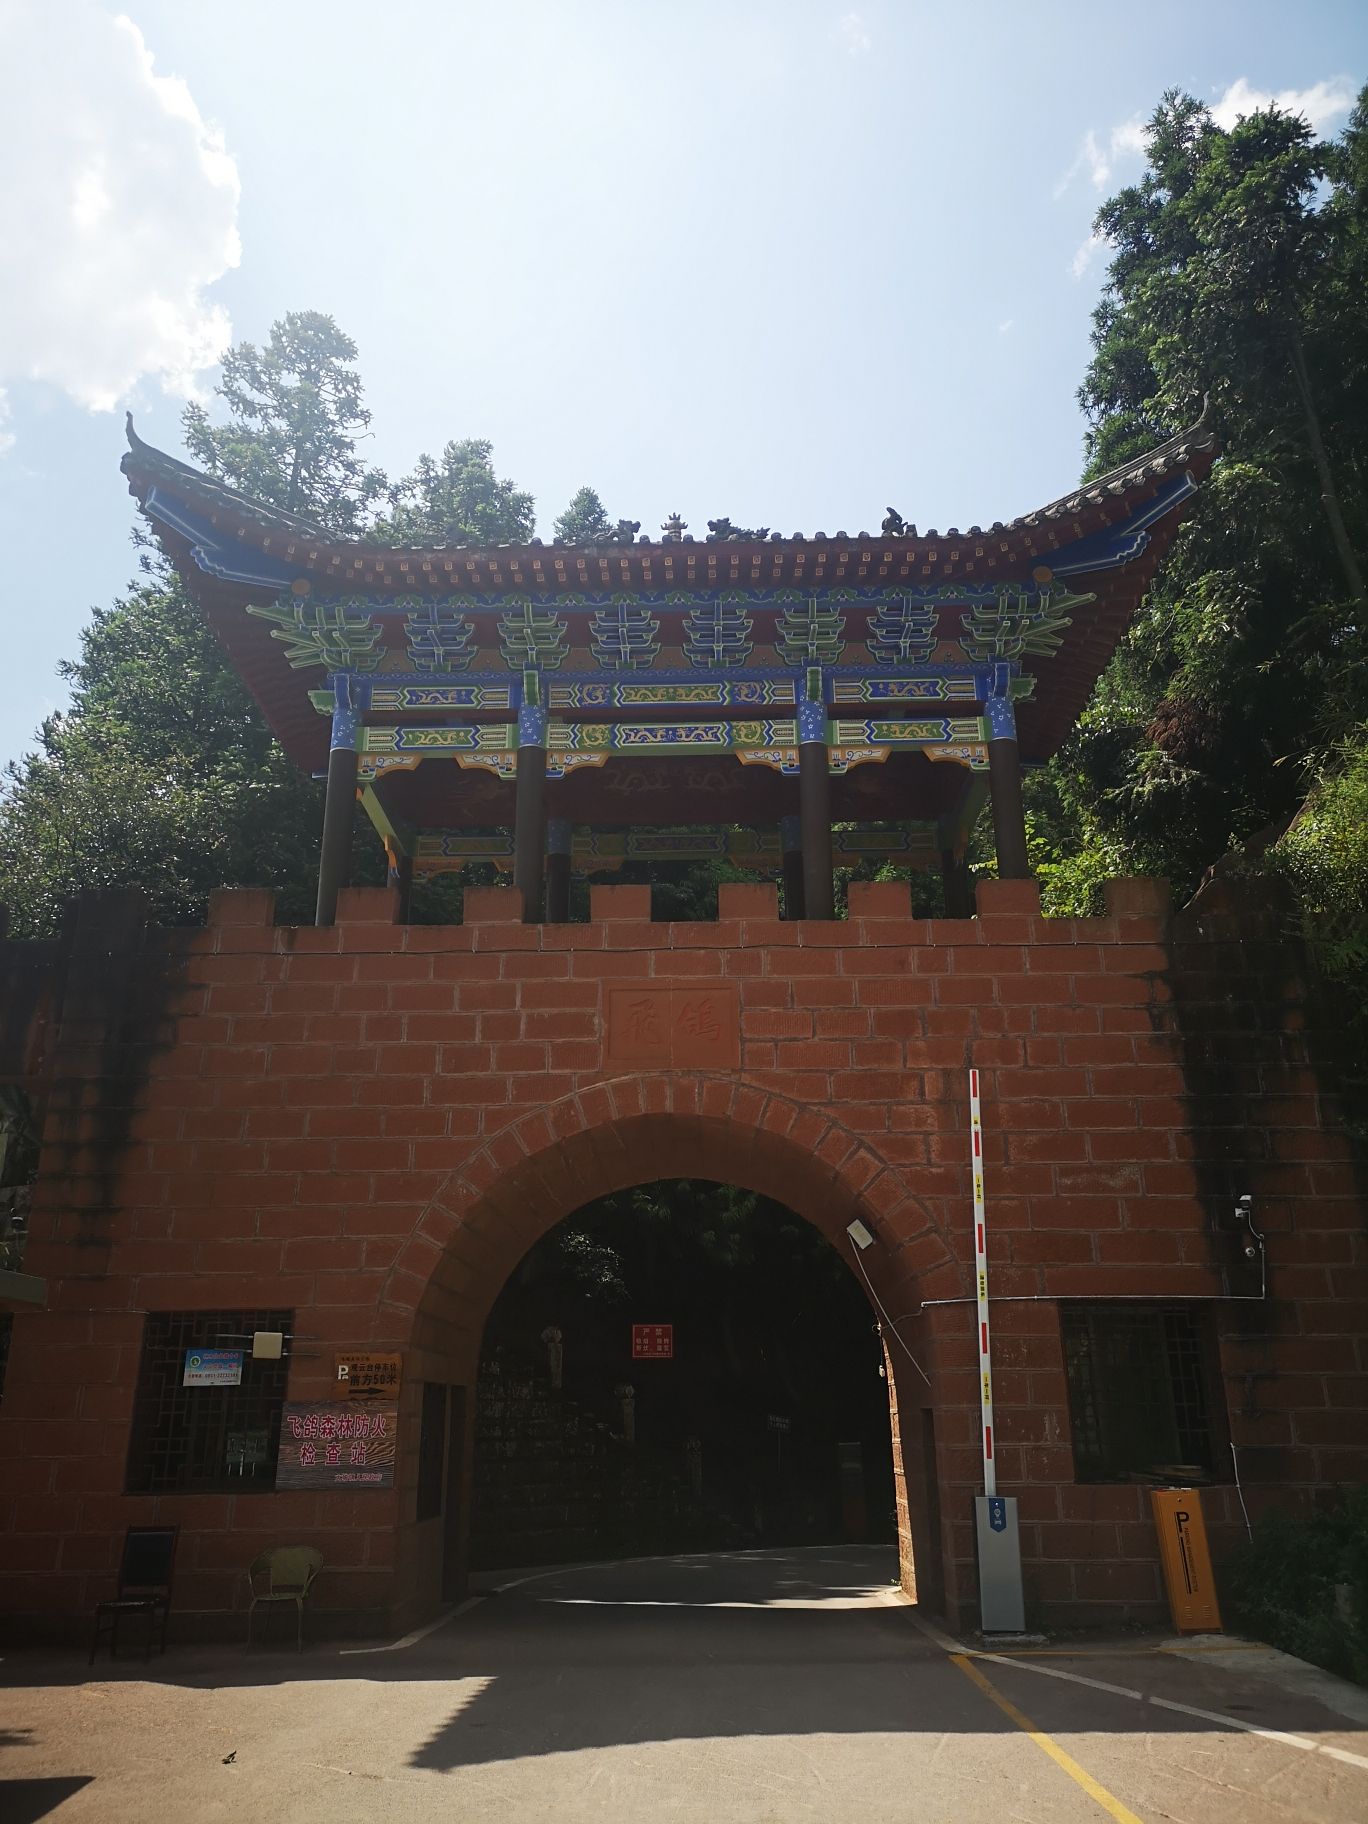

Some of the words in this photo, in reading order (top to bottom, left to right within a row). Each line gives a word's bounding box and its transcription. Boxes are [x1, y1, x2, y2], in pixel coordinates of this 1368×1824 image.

[350, 1374, 397, 1386] 前方50米
[287, 1414, 387, 1438] 飞鸽森林防火
[299, 1442, 367, 1466] 检查站
[1175, 1511, 1190, 1533] P
